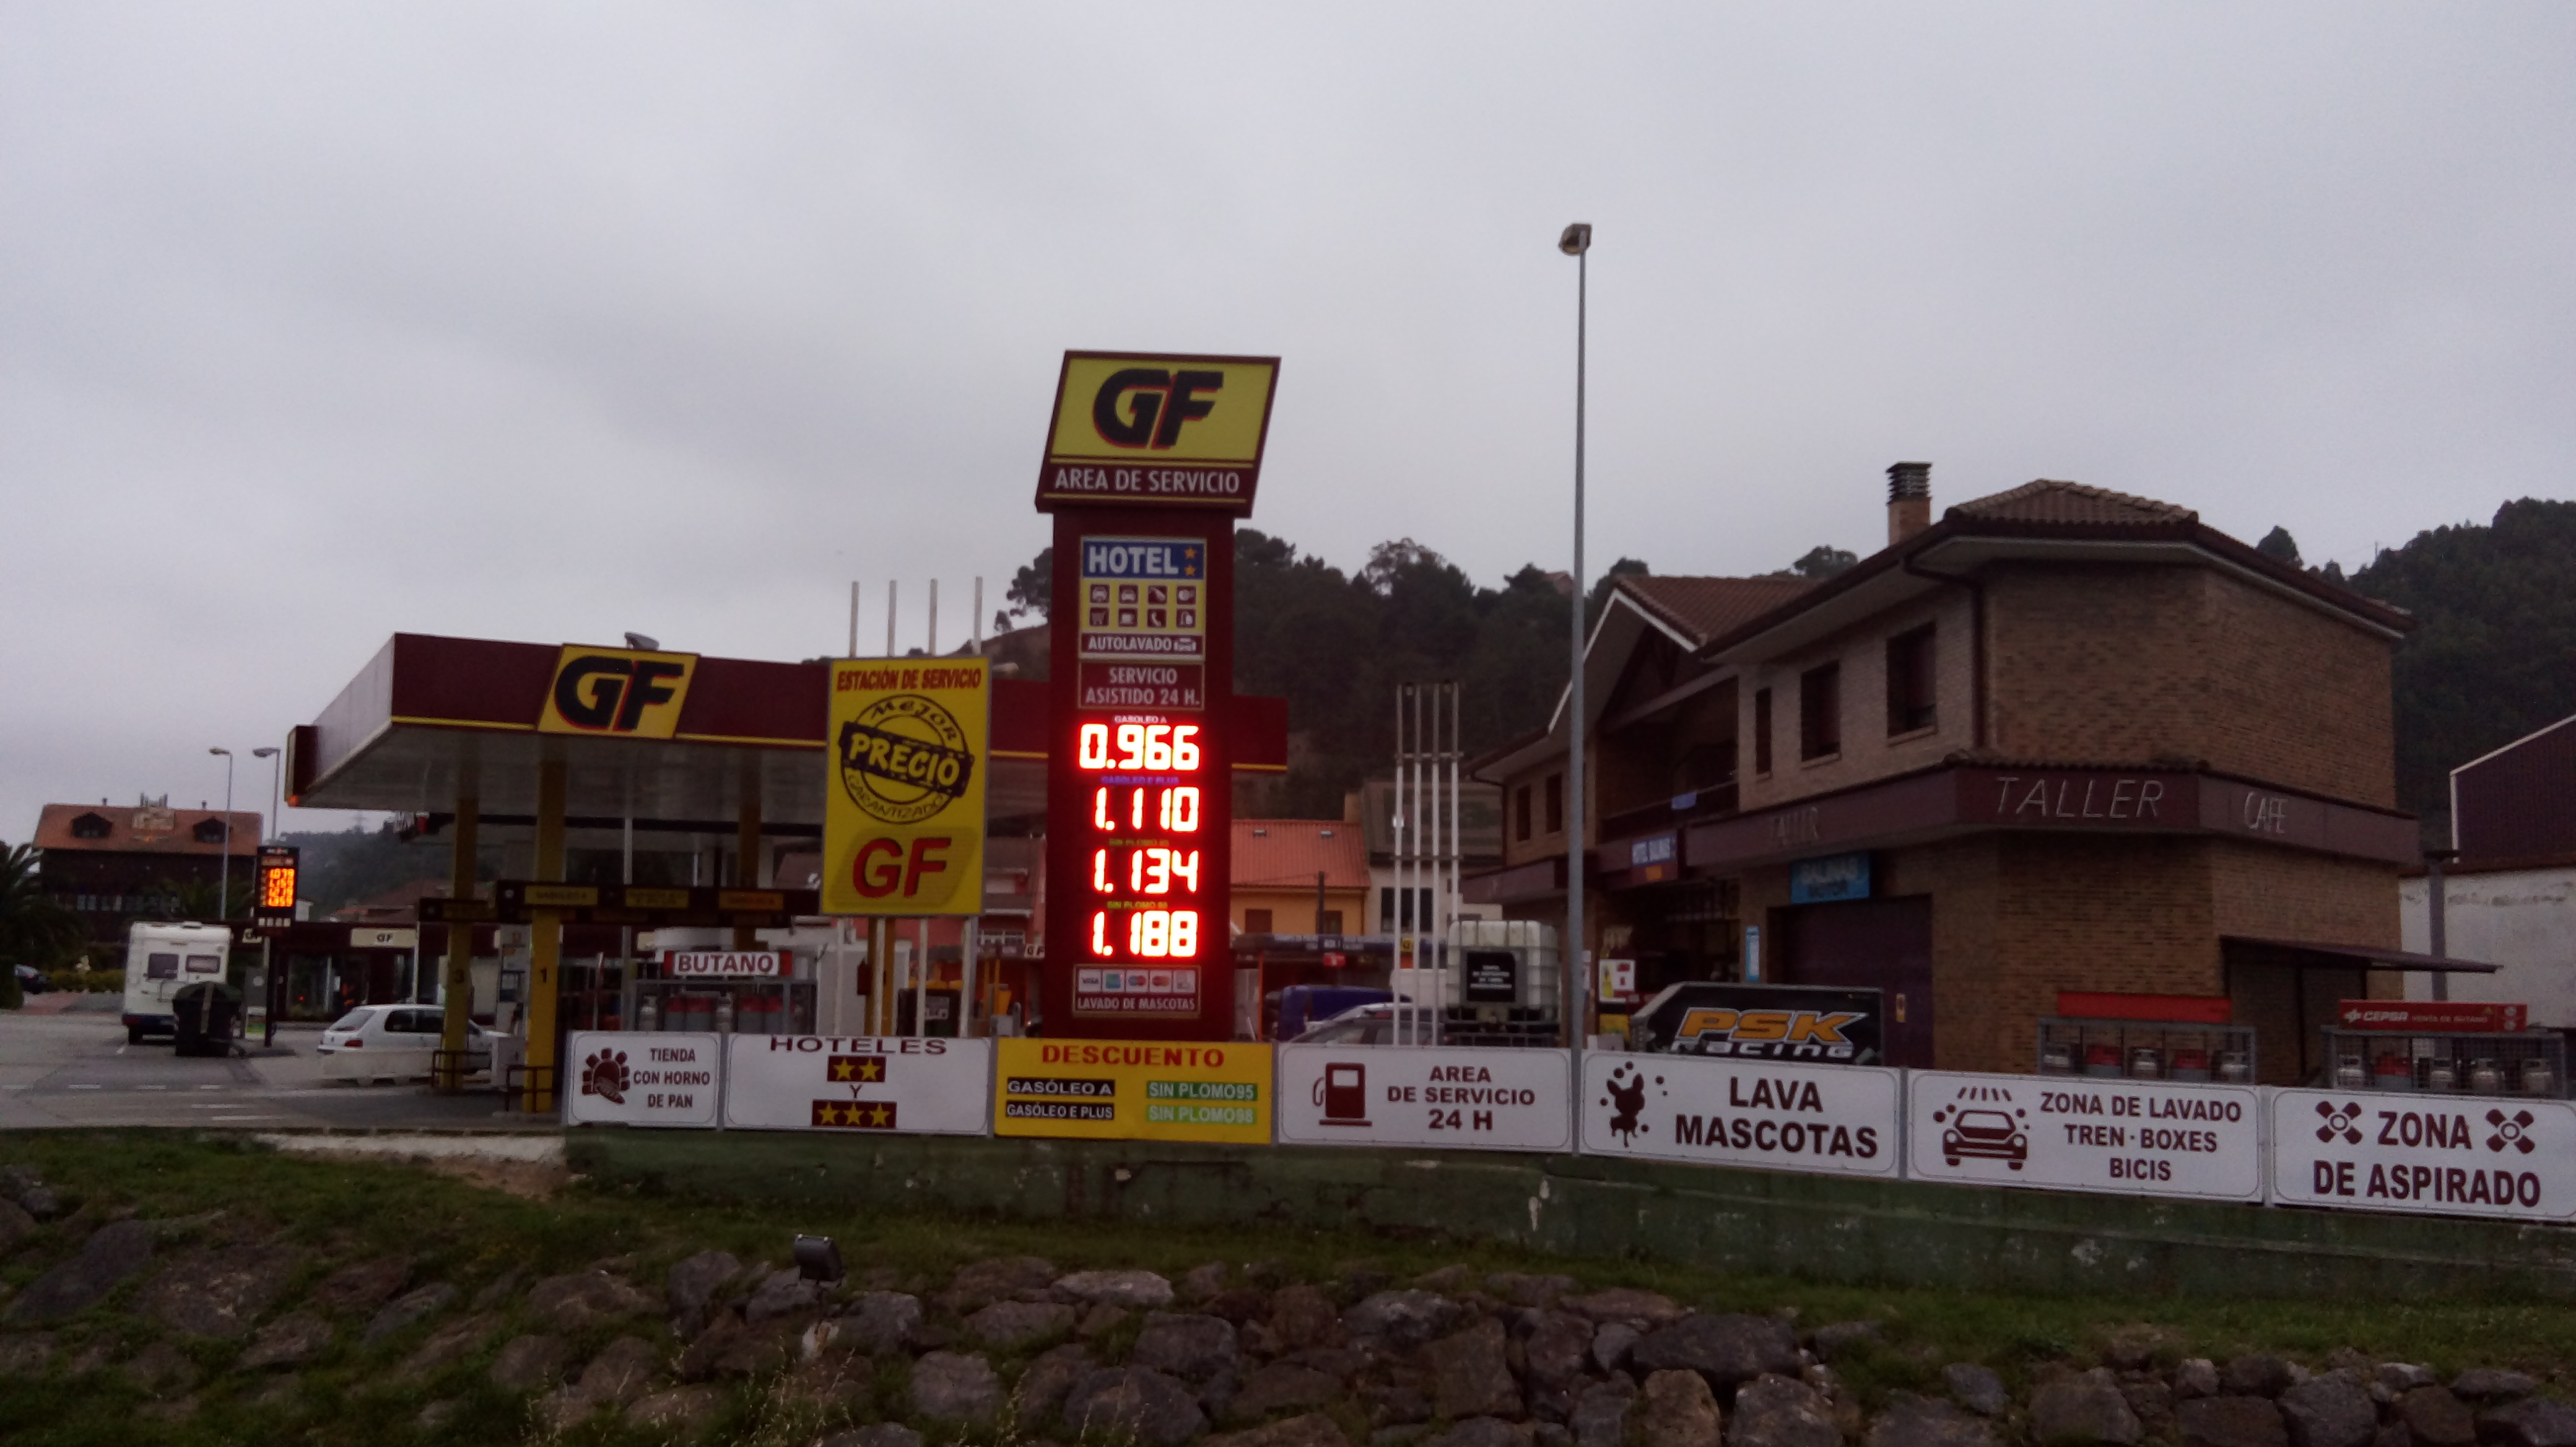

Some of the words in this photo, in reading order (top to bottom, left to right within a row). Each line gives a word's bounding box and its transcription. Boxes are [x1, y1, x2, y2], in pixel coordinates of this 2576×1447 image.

[1093, 368, 1224, 450] GF
[1055, 468, 1108, 490] AREA
[1115, 470, 1142, 491] DE
[1149, 471, 1240, 494] SERVICIO
[1089, 546, 1179, 574] HOTEL
[1088, 636, 1172, 651] AUTOLAVADO
[837, 665, 899, 692] ESTACIÓN
[901, 669, 920, 689] DE
[921, 668, 981, 690] SERVICIO
[1109, 667, 1178, 684] SERVICIO
[554, 655, 685, 732] GF
[1086, 686, 1154, 704] ASISTIDO
[1160, 688, 1178, 704] 24
[1183, 688, 1200, 706] H.
[1079, 723, 1200, 771] 0.966
[848, 732, 960, 787] PRECIO
[1995, 776, 2164, 819] TALLER
[1094, 787, 1200, 832] 1.110
[853, 837, 952, 899] GF
[1093, 848, 1199, 893] 1.134
[1092, 911, 1199, 957] 1.188
[677, 955, 774, 973] BUTANO
[540, 968, 548, 984] 1
[1077, 997, 1119, 1010] LAVADO
[1123, 998, 1134, 1010] DE
[1138, 997, 1195, 1010] MASCOTAS
[1674, 1007, 1869, 1045] PSK
[650, 1047, 696, 1062] TIENDA
[770, 1036, 947, 1055] HOTELES
[1042, 1044, 1225, 1067] DESCUENTO
[633, 1070, 660, 1085] CON
[664, 1070, 711, 1086] HORNO
[1429, 1065, 1492, 1083] AREA
[849, 1084, 863, 1099] Y
[1007, 1078, 1095, 1095] GASÓLEO
[1099, 1081, 1113, 1096] A
[1149, 1083, 1175, 1098] SIN
[1387, 1086, 1417, 1103] DE
[1424, 1086, 1536, 1106] SERVICIO
[1730, 1076, 1824, 1113] LAVA
[647, 1093, 663, 1108] DE
[669, 1094, 693, 1108] PAN
[1070, 1105, 1077, 1118] E
[1081, 1105, 1113, 1119] PLUS
[2040, 1091, 2104, 1115] ZONA
[2111, 1095, 2141, 1117] DE
[2148, 1097, 2242, 1122] LAVADO
[1149, 1106, 1175, 1121] SIN
[1428, 1109, 1463, 1130] 24
[1473, 1110, 1493, 1131] H
[1675, 1114, 1879, 1158] MASCOTAS
[2377, 1111, 2473, 1150] ZONA
[2109, 1158, 2172, 1181] BICIS
[2313, 1160, 2356, 1196] DE
[2367, 1163, 2541, 1208] ASPIRADO
